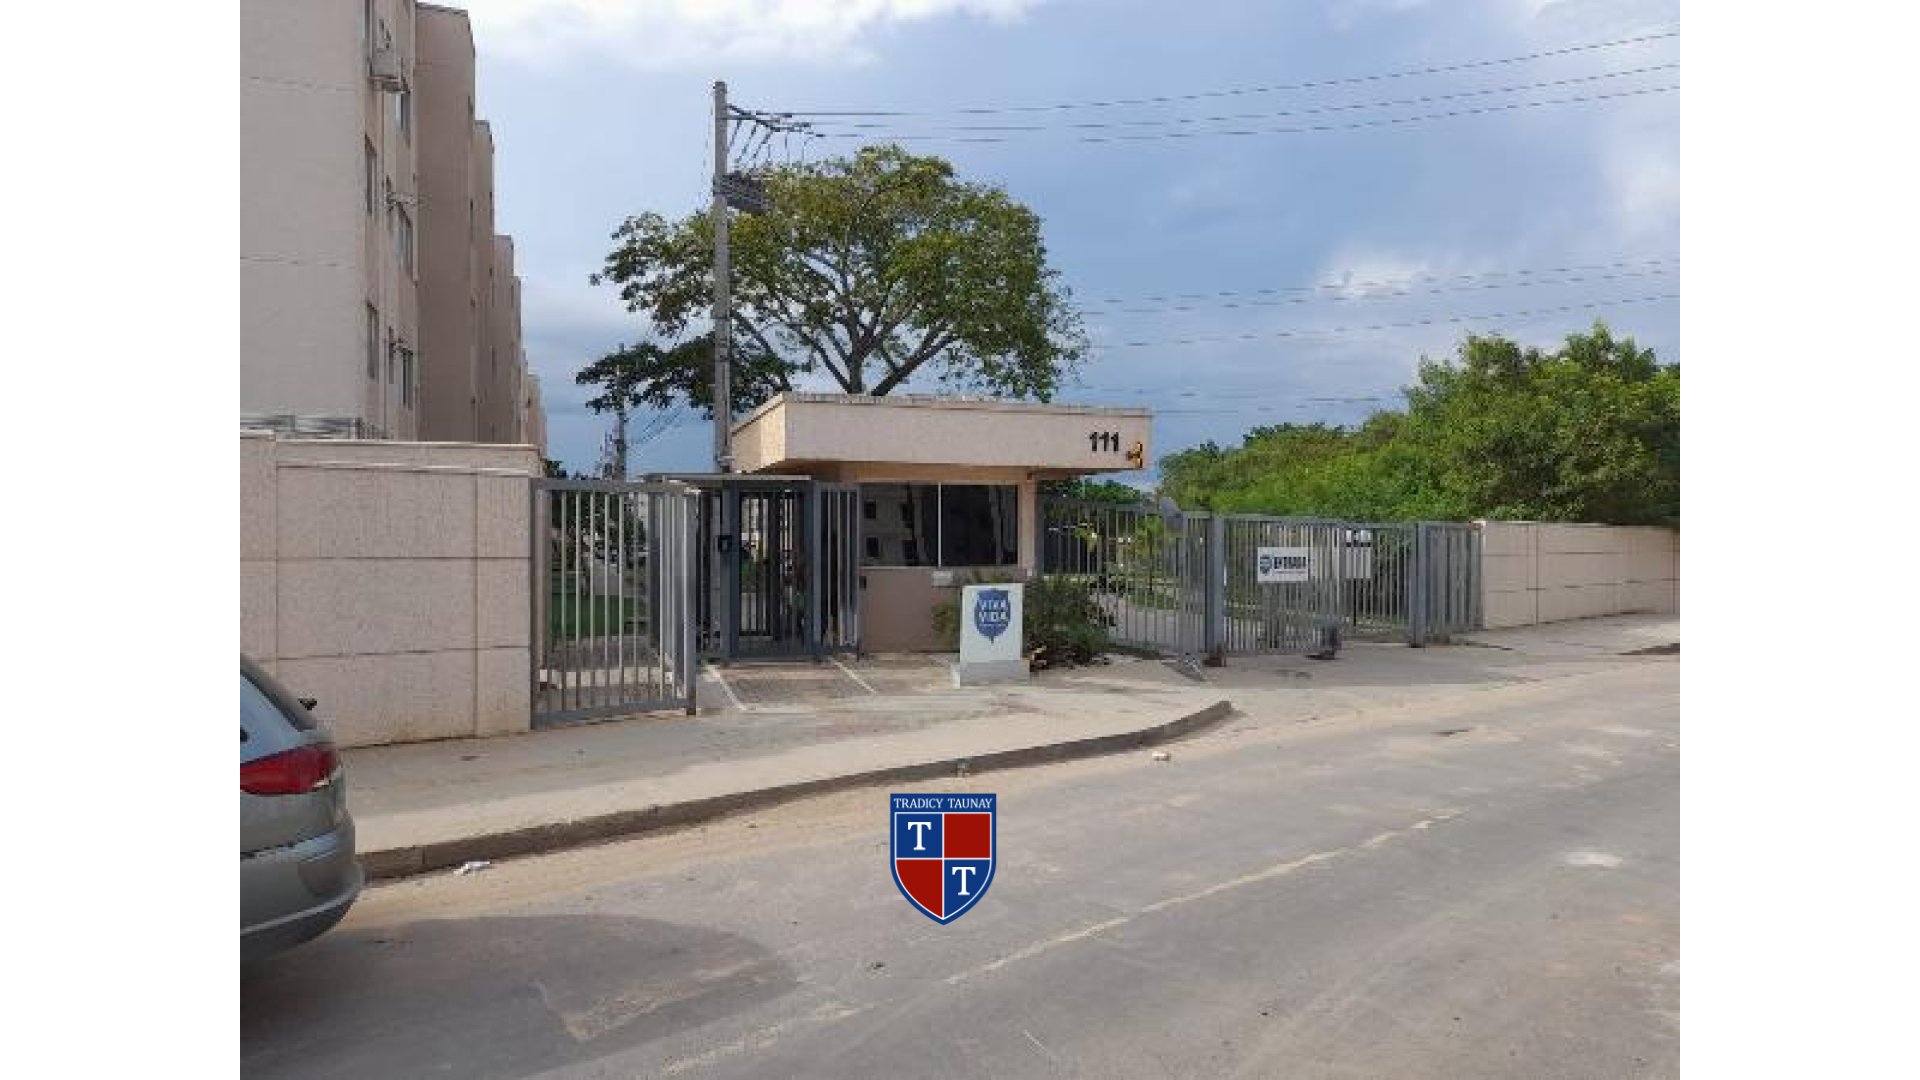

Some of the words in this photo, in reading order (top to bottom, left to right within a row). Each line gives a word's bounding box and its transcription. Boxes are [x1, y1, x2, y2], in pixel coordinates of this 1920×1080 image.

[1089, 431, 1119, 452] 111
[978, 600, 1009, 611] VIVA
[978, 611, 1009, 623] VIDA
